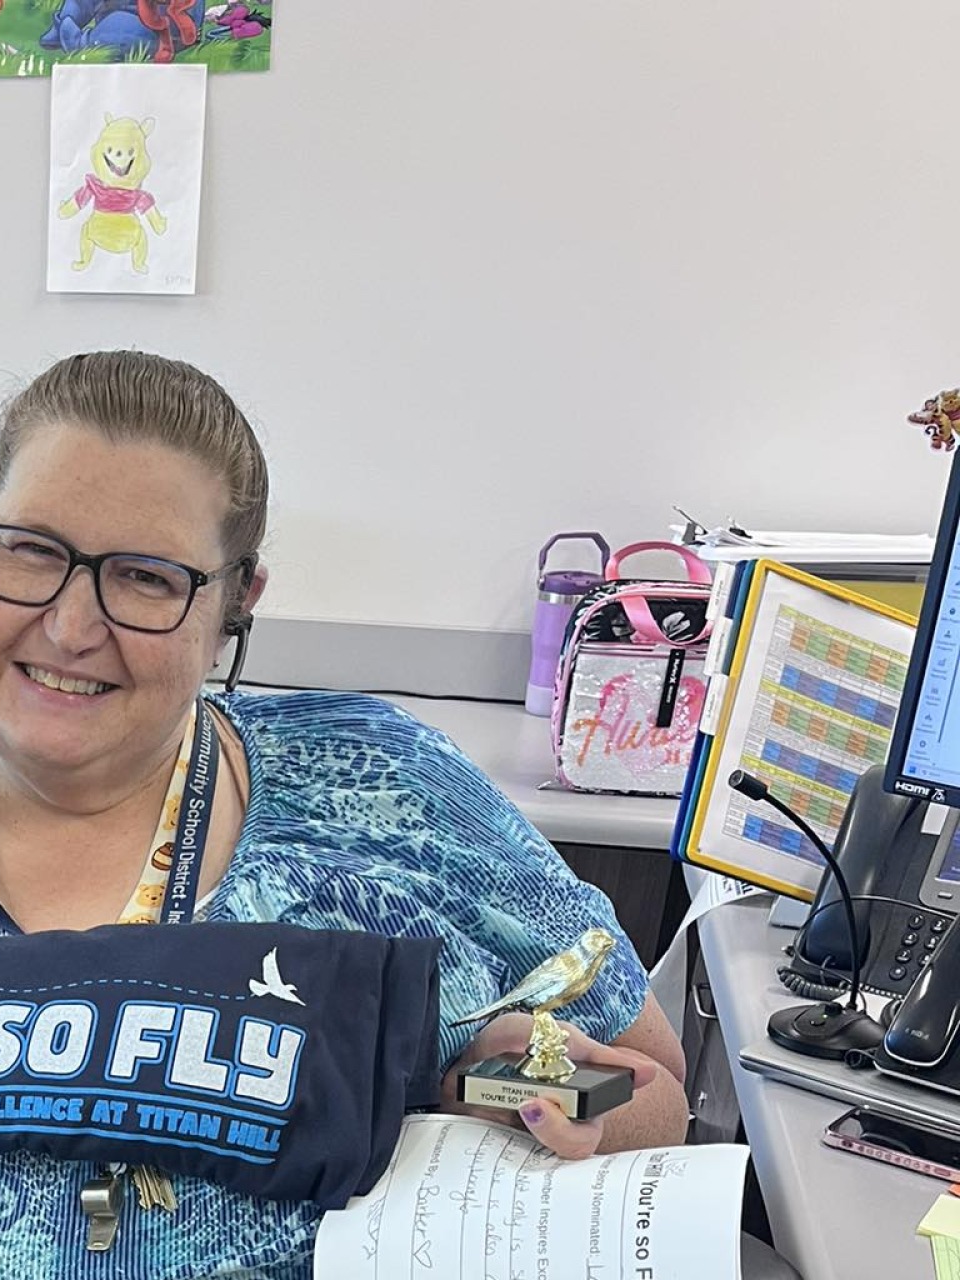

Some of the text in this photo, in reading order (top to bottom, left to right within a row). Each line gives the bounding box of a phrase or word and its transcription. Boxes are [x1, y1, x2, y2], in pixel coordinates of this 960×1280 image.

[190, 709, 217, 795] Community
[181, 799, 206, 851] School
[171, 851, 193, 900] District
[104, 999, 307, 1111] FLY
[480, 1092, 506, 1103] YOU'RE
[508, 1096, 519, 1104] SO
[501, 1086, 522, 1096] TITAN
[91, 1099, 124, 1126] AT
[138, 1103, 222, 1141] TITAN
[227, 1120, 281, 1152] HILL
[429, 1123, 452, 1164] Nominated
[414, 1184, 440, 1240] Barker
[489, 1199, 500, 1210] is
[504, 1200, 527, 1228] only
[589, 1192, 604, 1258] Nominated:
[636, 1180, 659, 1230] You're
[486, 1223, 503, 1257] also
[511, 1237, 526, 1251] is
[537, 1208, 553, 1255] Inspires
[635, 1236, 650, 1260] so
